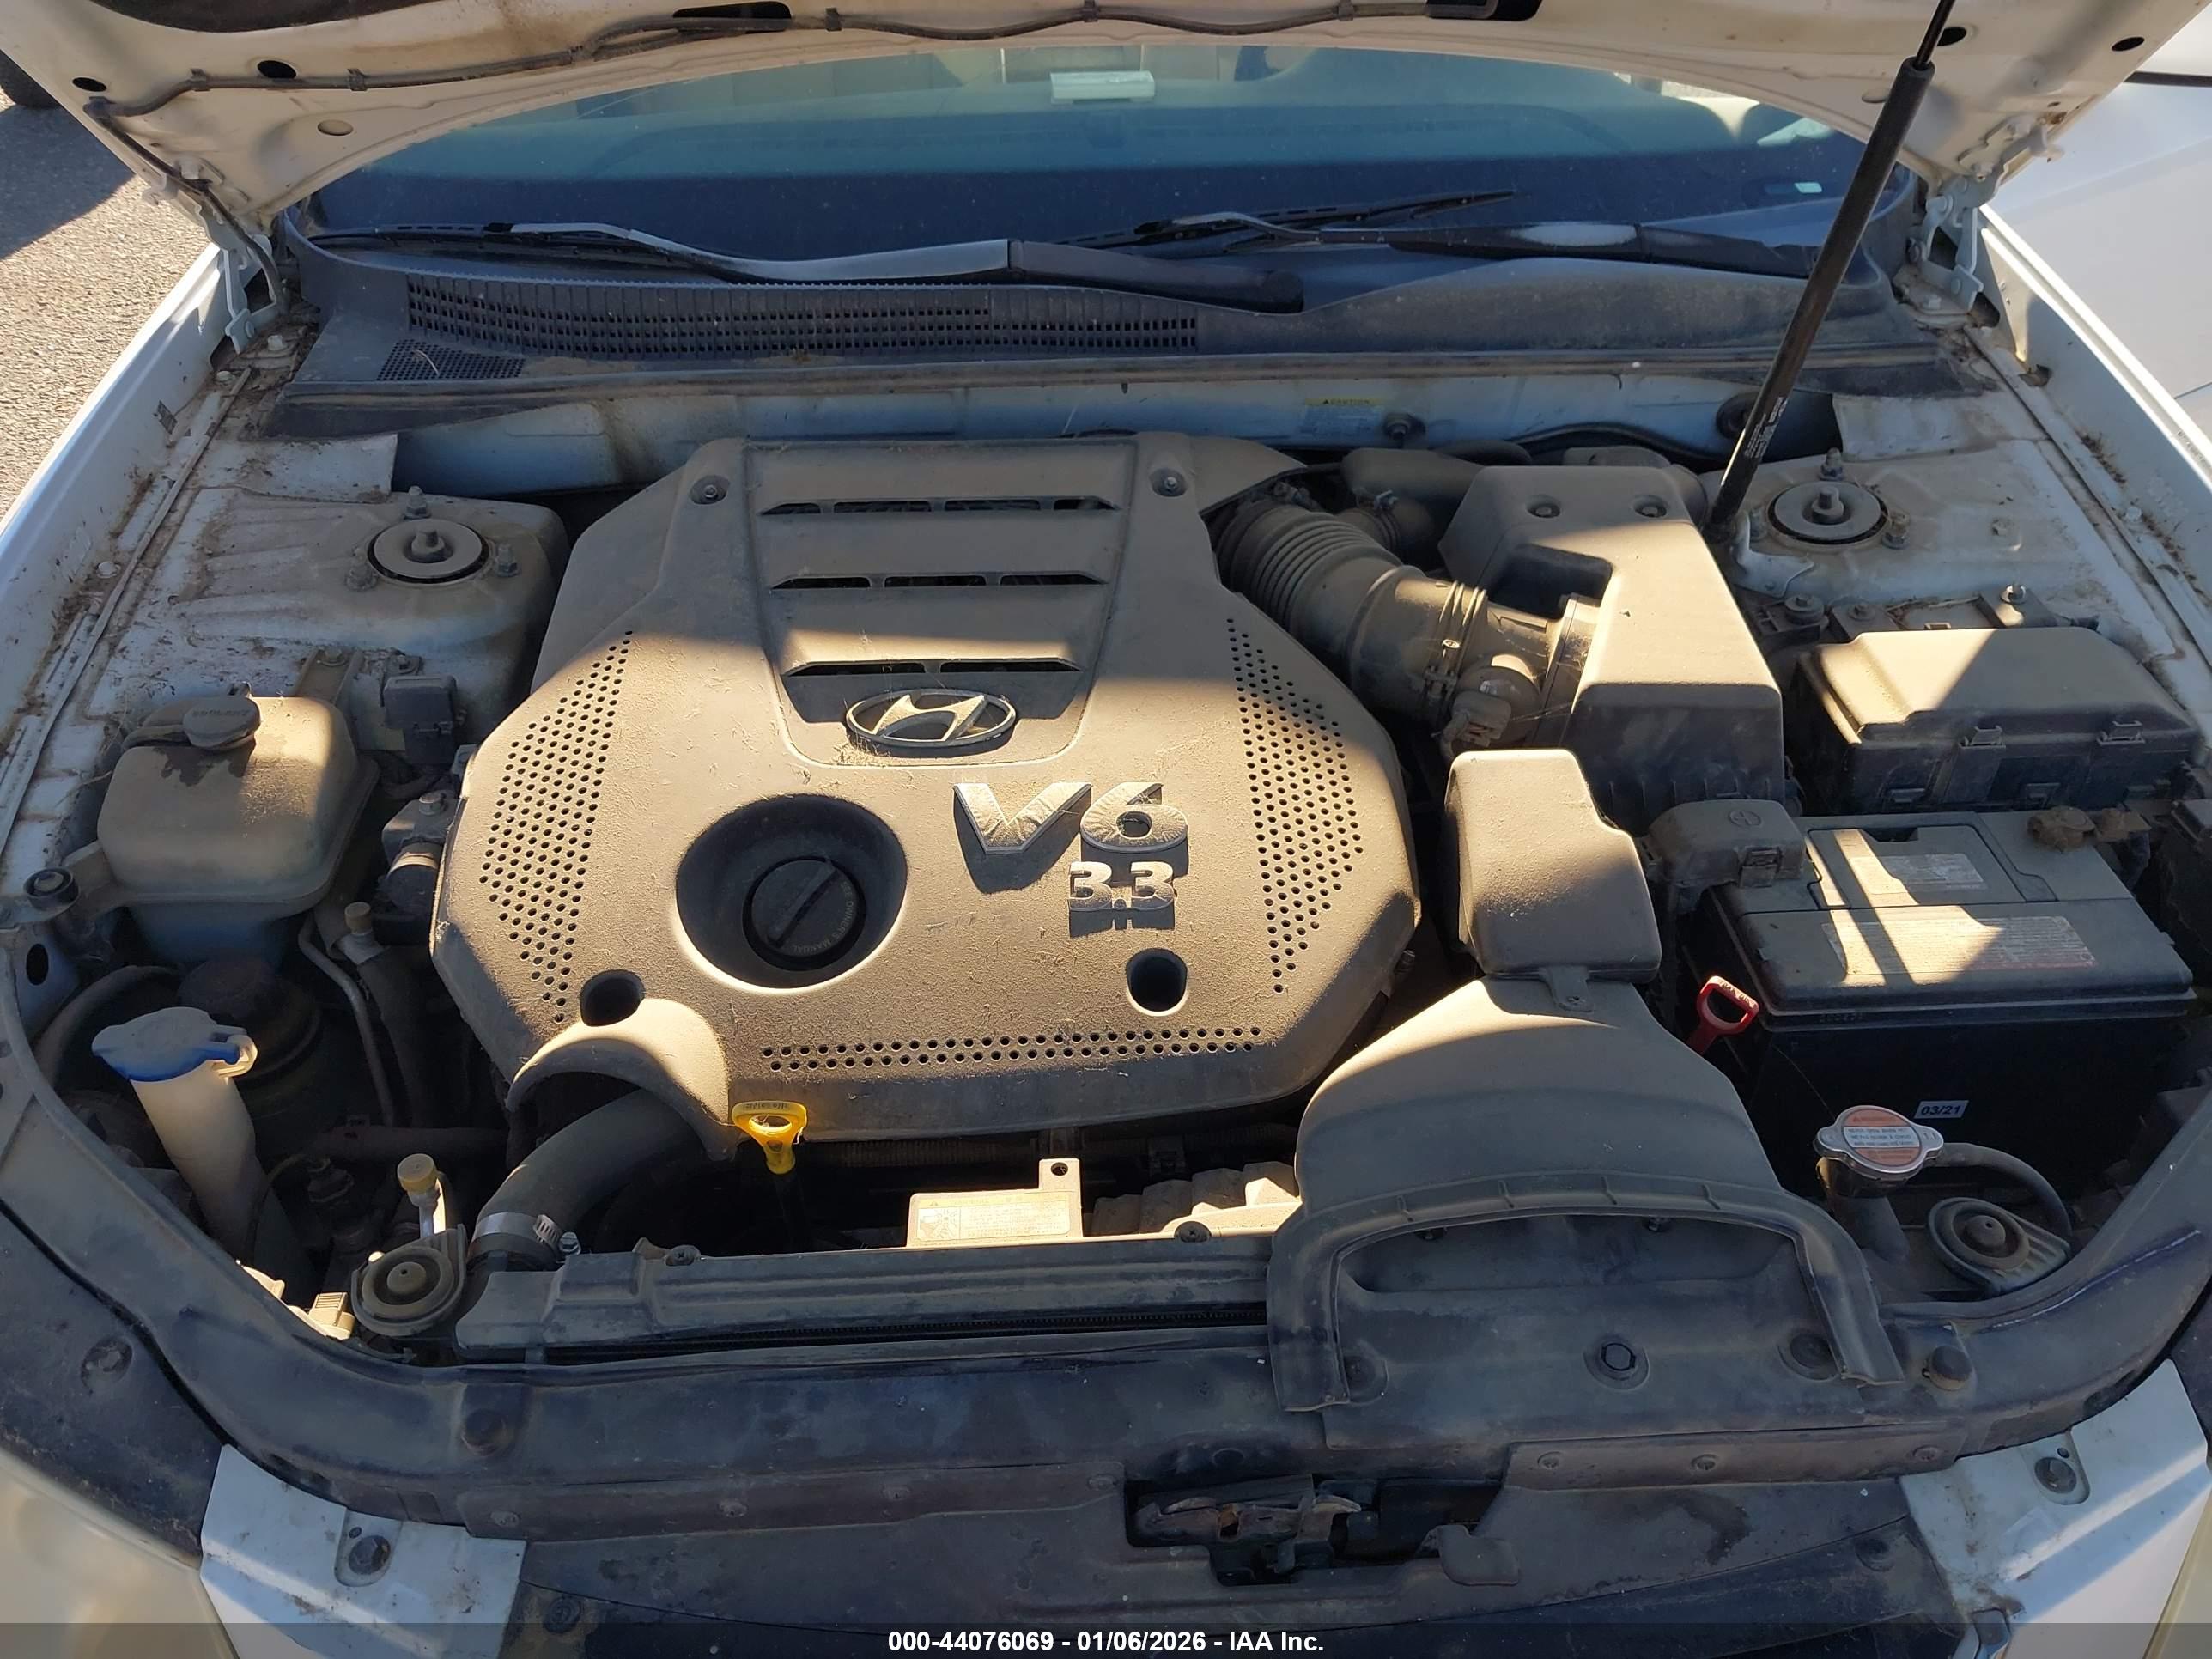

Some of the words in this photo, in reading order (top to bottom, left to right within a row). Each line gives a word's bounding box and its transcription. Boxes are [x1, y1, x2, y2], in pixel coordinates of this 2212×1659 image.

[953, 781, 1189, 854] V6
[1067, 860, 1177, 912] 3.3
[1921, 1105, 1961, 1115] 03/21
